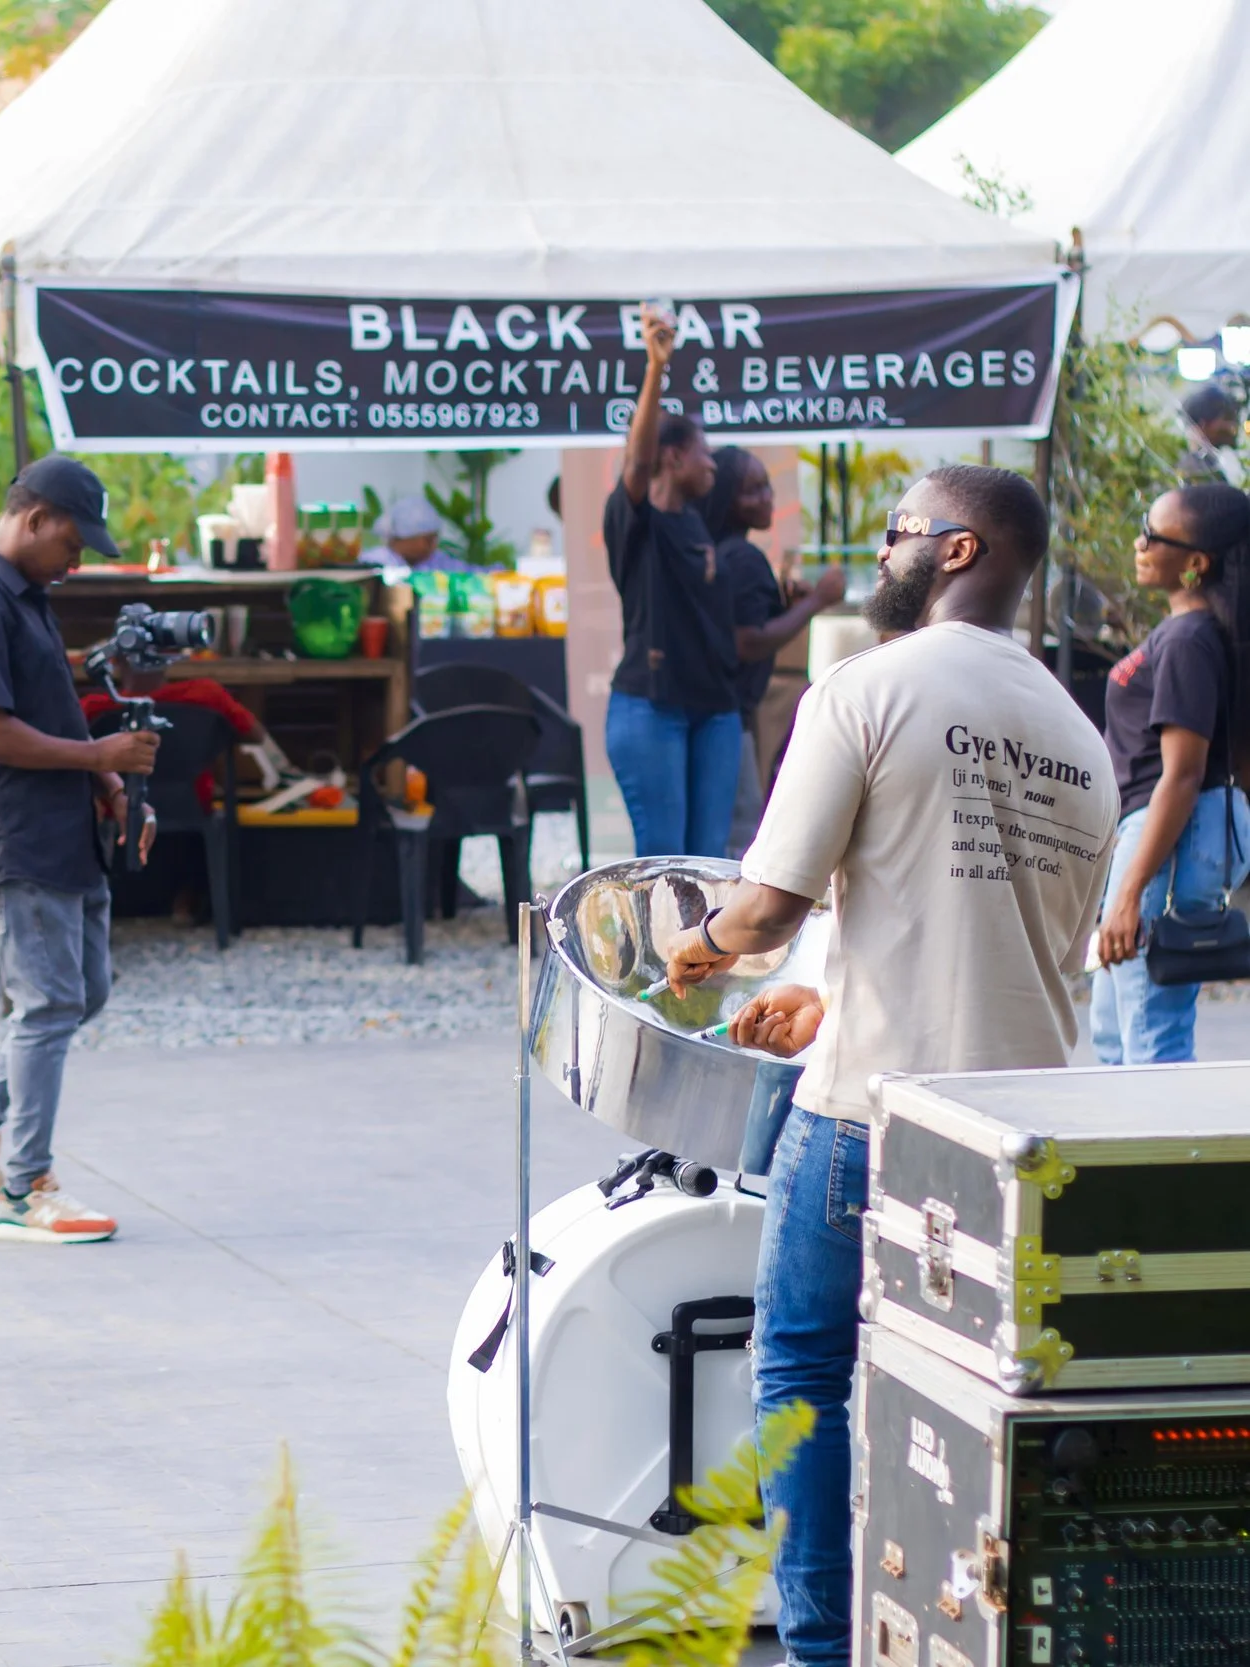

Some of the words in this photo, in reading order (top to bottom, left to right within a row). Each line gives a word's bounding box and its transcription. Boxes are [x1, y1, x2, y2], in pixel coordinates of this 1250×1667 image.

[349, 304, 592, 351] BLACK
[619, 303, 764, 350] BAR
[54, 357, 359, 400] COCKTAILS,
[692, 357, 719, 393] &
[741, 349, 1036, 393] BEVERAGES
[200, 403, 359, 428] CONTACT:
[368, 402, 540, 428] 0555967923
[945, 725, 997, 764] Gye
[1002, 738, 1092, 790] Nyame
[971, 773, 1012, 797] nyme]
[1024, 788, 1055, 808] noun
[953, 810, 964, 824] It
[1009, 824, 1027, 839] the
[950, 864, 964, 877] in
[969, 865, 983, 879] all
[952, 838, 975, 852] and
[1025, 855, 1037, 868] of
[1038, 857, 1062, 877] God;
[1038, 1636, 1047, 1650] R
